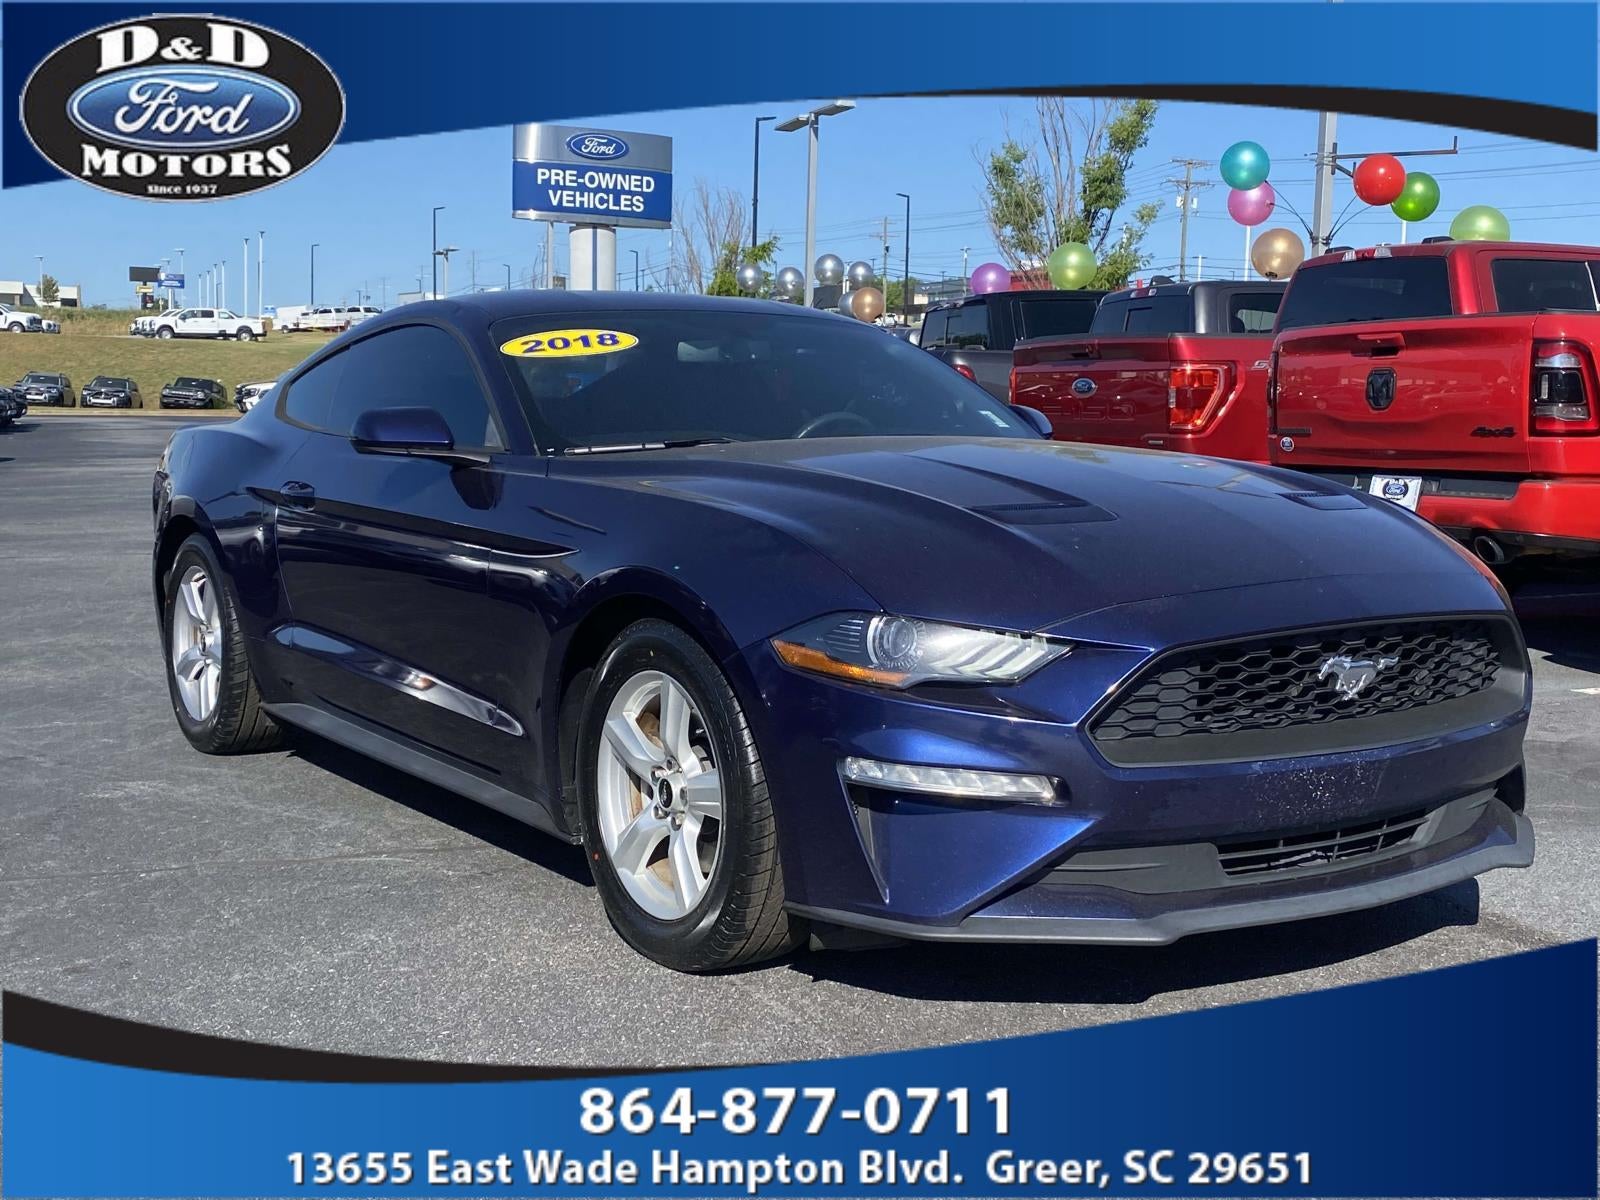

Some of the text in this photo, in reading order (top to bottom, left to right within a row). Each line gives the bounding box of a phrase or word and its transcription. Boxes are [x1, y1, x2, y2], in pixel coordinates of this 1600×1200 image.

[581, 137, 616, 155] Ford
[536, 168, 655, 193] PRE-OWNED
[548, 189, 645, 212] VEHICLES
[520, 333, 620, 354] 2018
